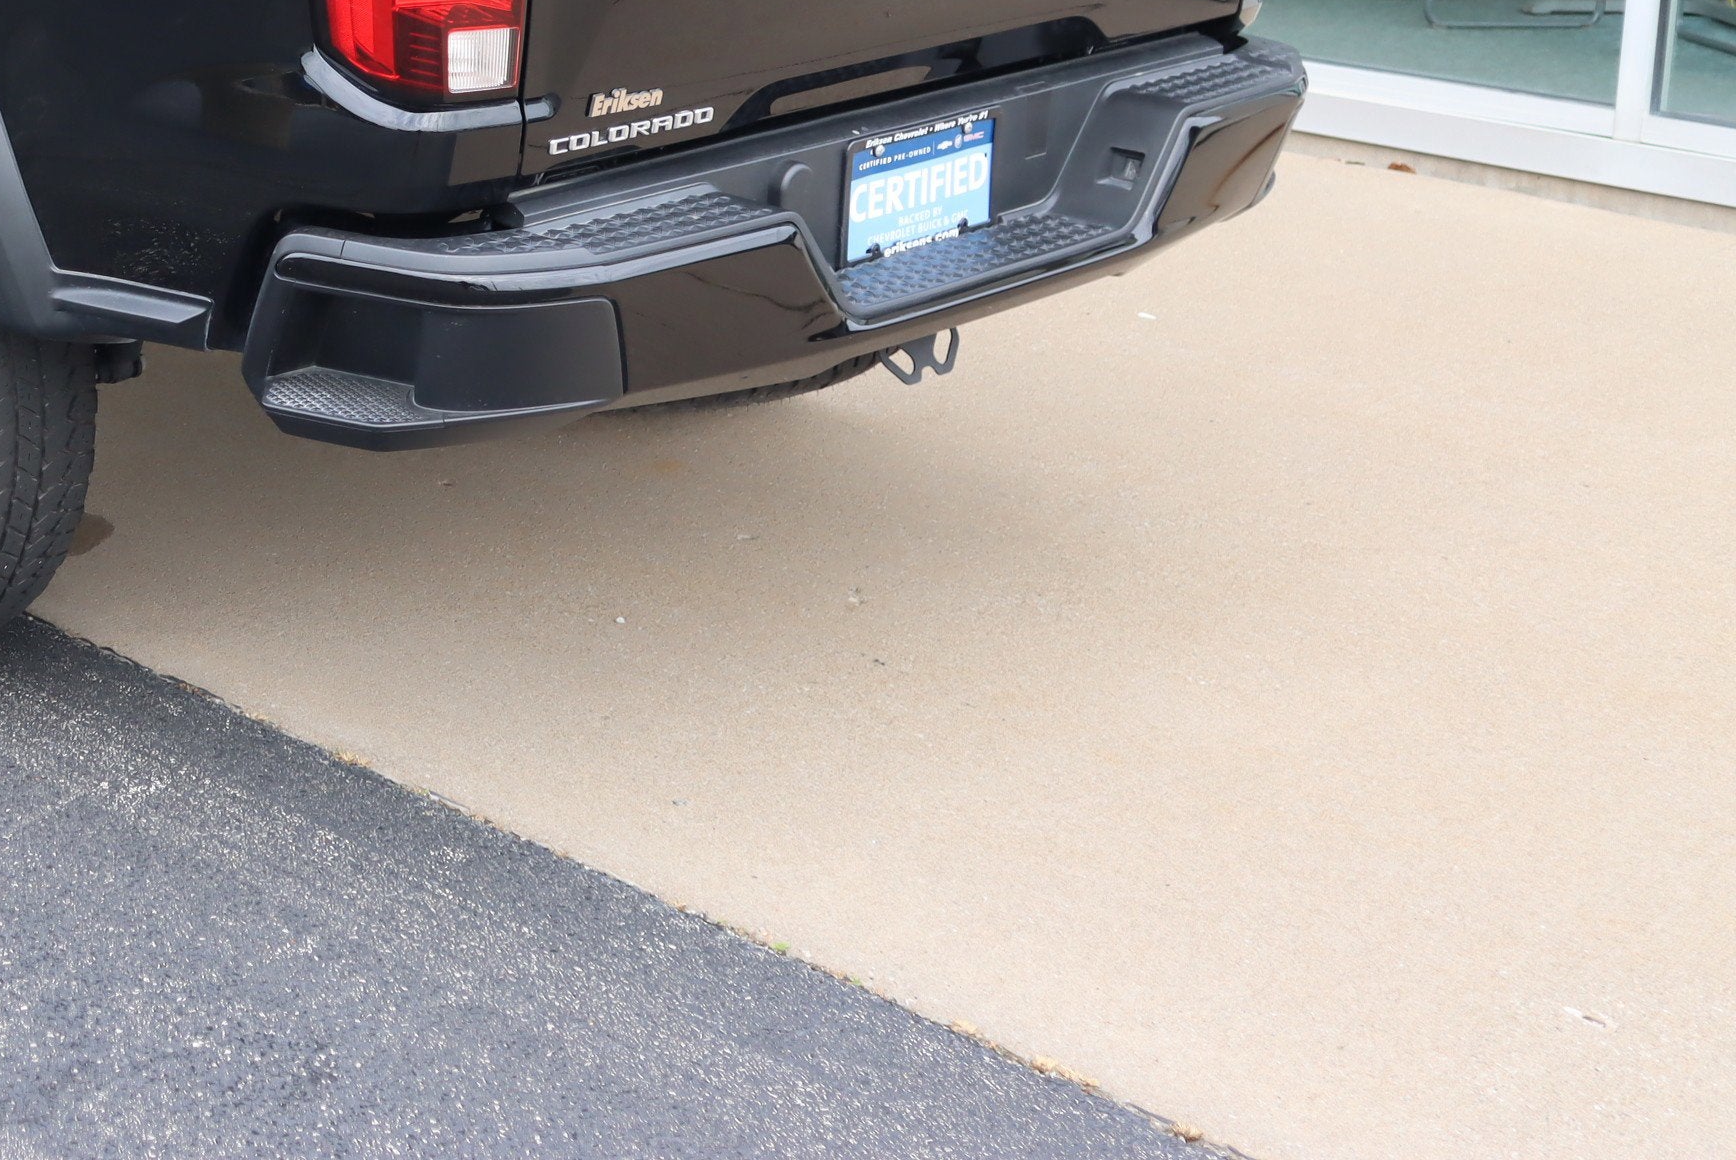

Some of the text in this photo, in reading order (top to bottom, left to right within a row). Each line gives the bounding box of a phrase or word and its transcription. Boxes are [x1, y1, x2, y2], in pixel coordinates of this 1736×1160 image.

[588, 86, 664, 118] Eriksen
[547, 105, 715, 156] COLORADO
[859, 146, 932, 171] CERTIFIED PRE-OWNED
[848, 152, 989, 223] CERTIFIED
